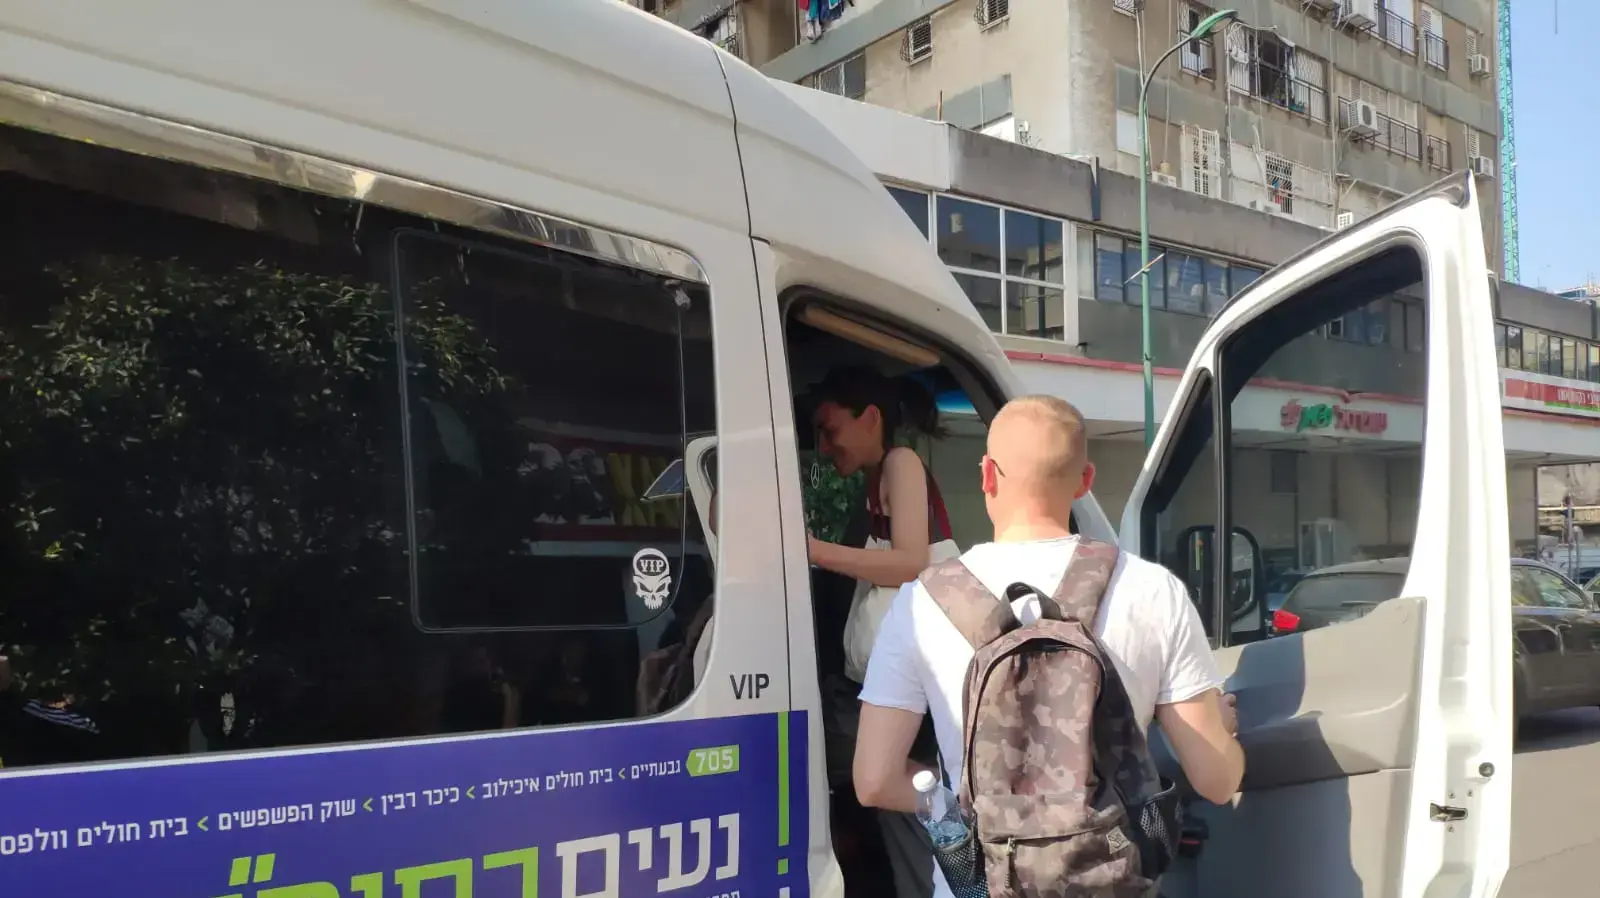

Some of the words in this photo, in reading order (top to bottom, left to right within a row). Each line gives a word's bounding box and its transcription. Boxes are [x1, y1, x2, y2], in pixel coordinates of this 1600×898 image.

[639, 559, 666, 573] VIP
[730, 673, 770, 700] VIP
[630, 760, 681, 779] גבעתיים
[695, 749, 733, 773] 705
[482, 775, 540, 799] איכילוב
[545, 770, 584, 791] חולים
[588, 767, 613, 785] בית
[381, 791, 416, 814] רבין
[423, 786, 460, 806] כיכר
[218, 802, 313, 831] הפשפשים
[320, 798, 356, 823] שוק
[77, 821, 140, 847] חולים
[149, 817, 189, 839] בית
[555, 813, 740, 898] נעים
